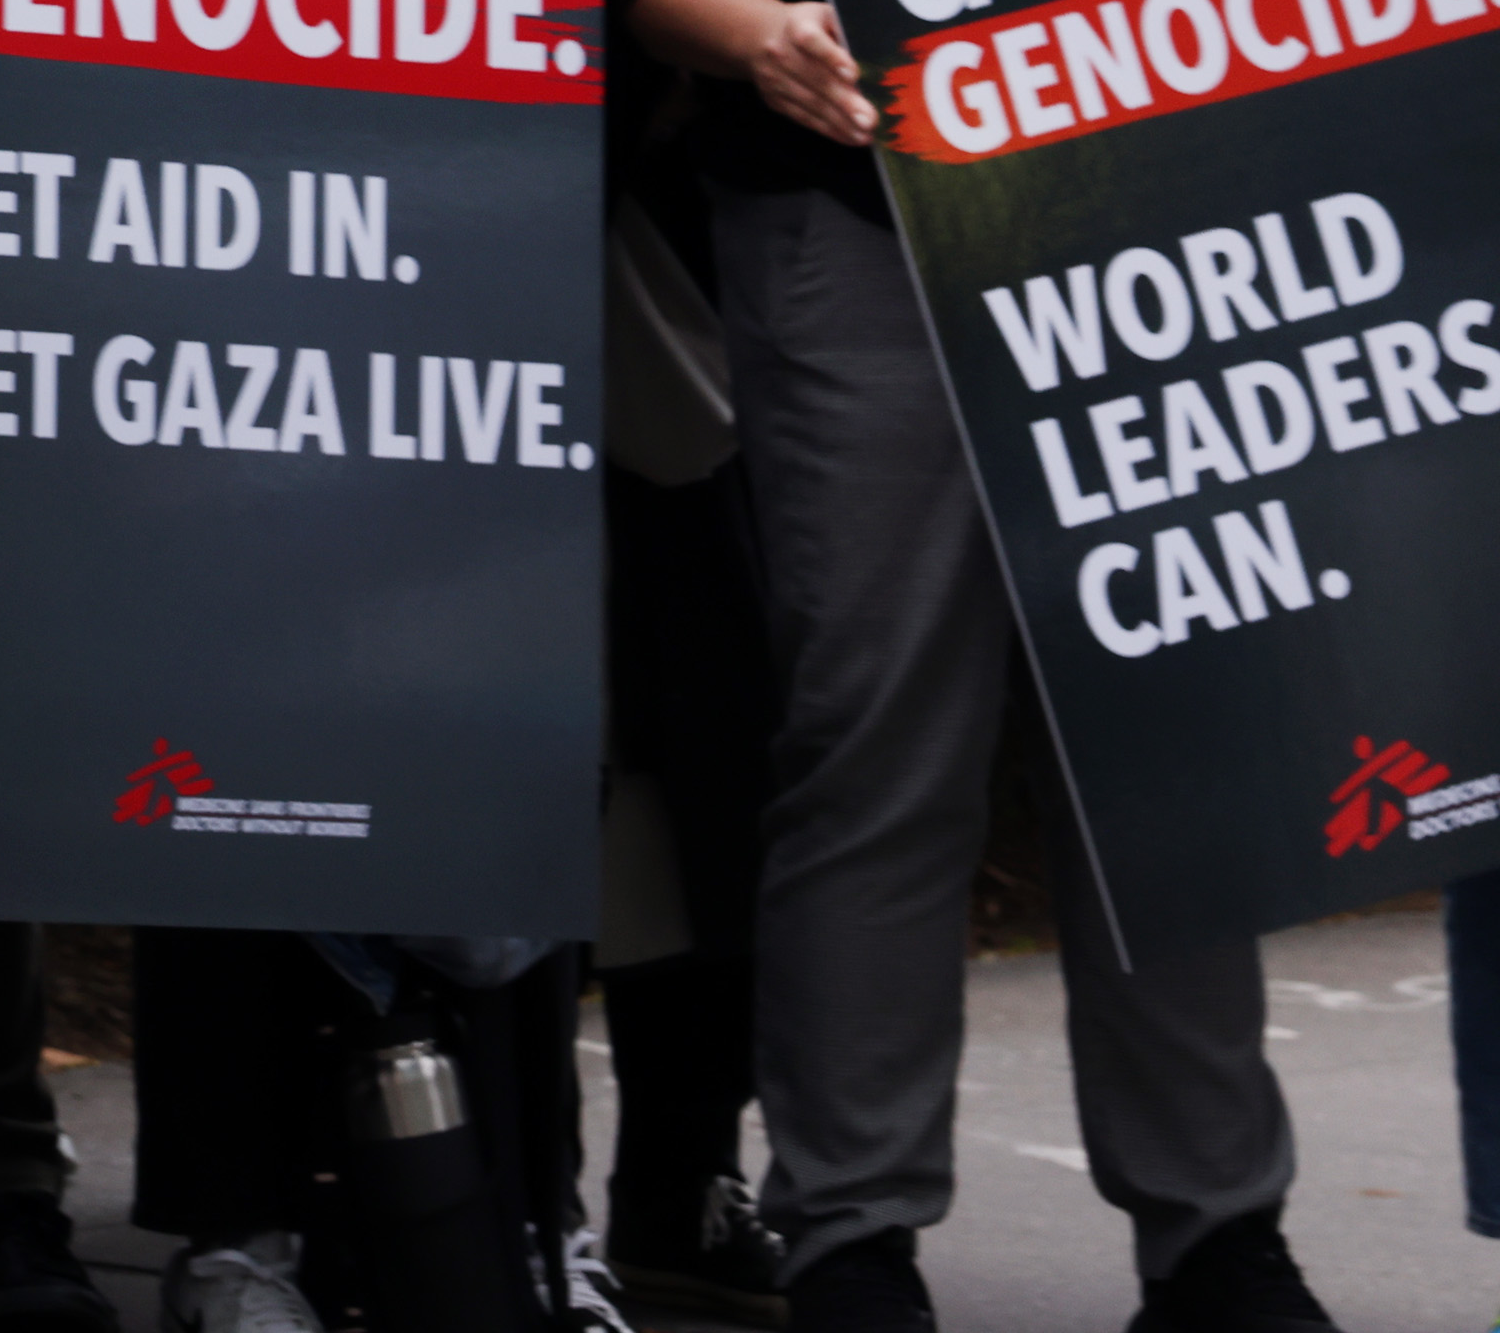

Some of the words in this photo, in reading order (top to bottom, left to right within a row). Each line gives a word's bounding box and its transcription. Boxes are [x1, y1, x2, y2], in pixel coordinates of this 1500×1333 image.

[90, 159, 259, 270] AID
[290, 171, 418, 283] IN.
[984, 194, 1401, 390] WORLD
[95, 335, 344, 455] GAZA
[371, 354, 592, 469] LIVE.
[1032, 301, 1500, 527] LEADERS
[1080, 501, 1349, 656] CAN.
